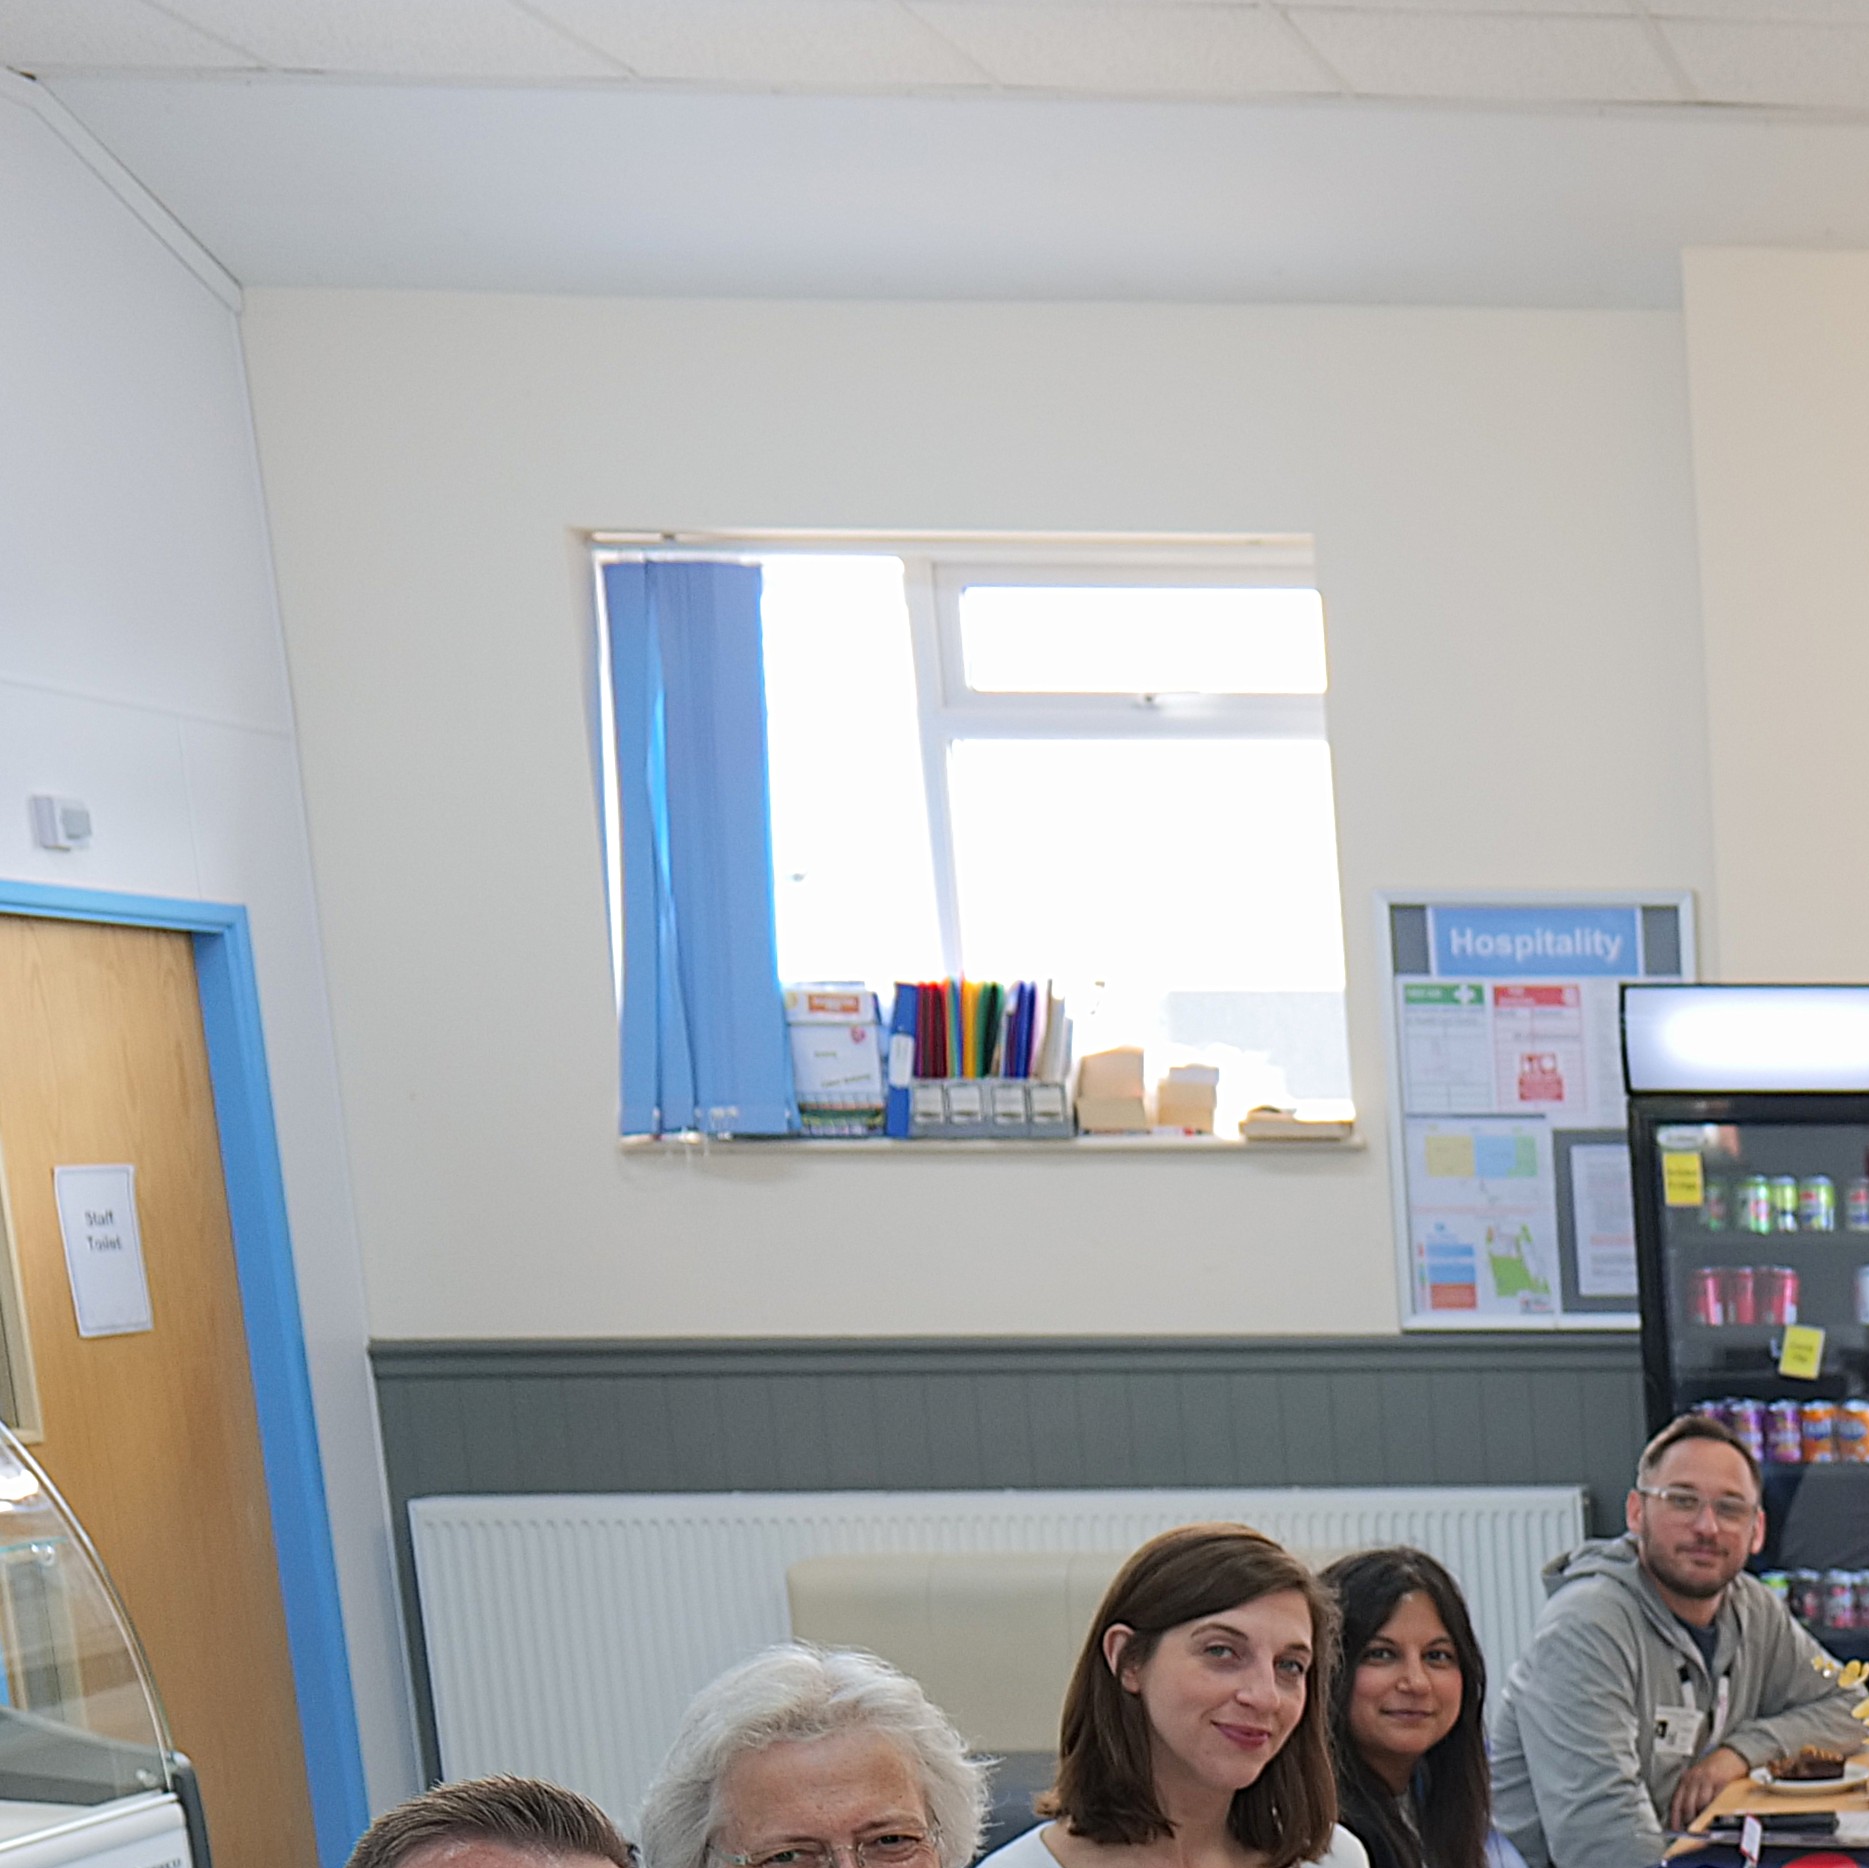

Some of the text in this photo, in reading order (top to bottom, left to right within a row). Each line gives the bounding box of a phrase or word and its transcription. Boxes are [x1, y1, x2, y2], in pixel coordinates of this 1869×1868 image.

[1450, 927, 1622, 964] Hospitality
[85, 1211, 114, 1227] Staff
[87, 1236, 122, 1251] Toilet
